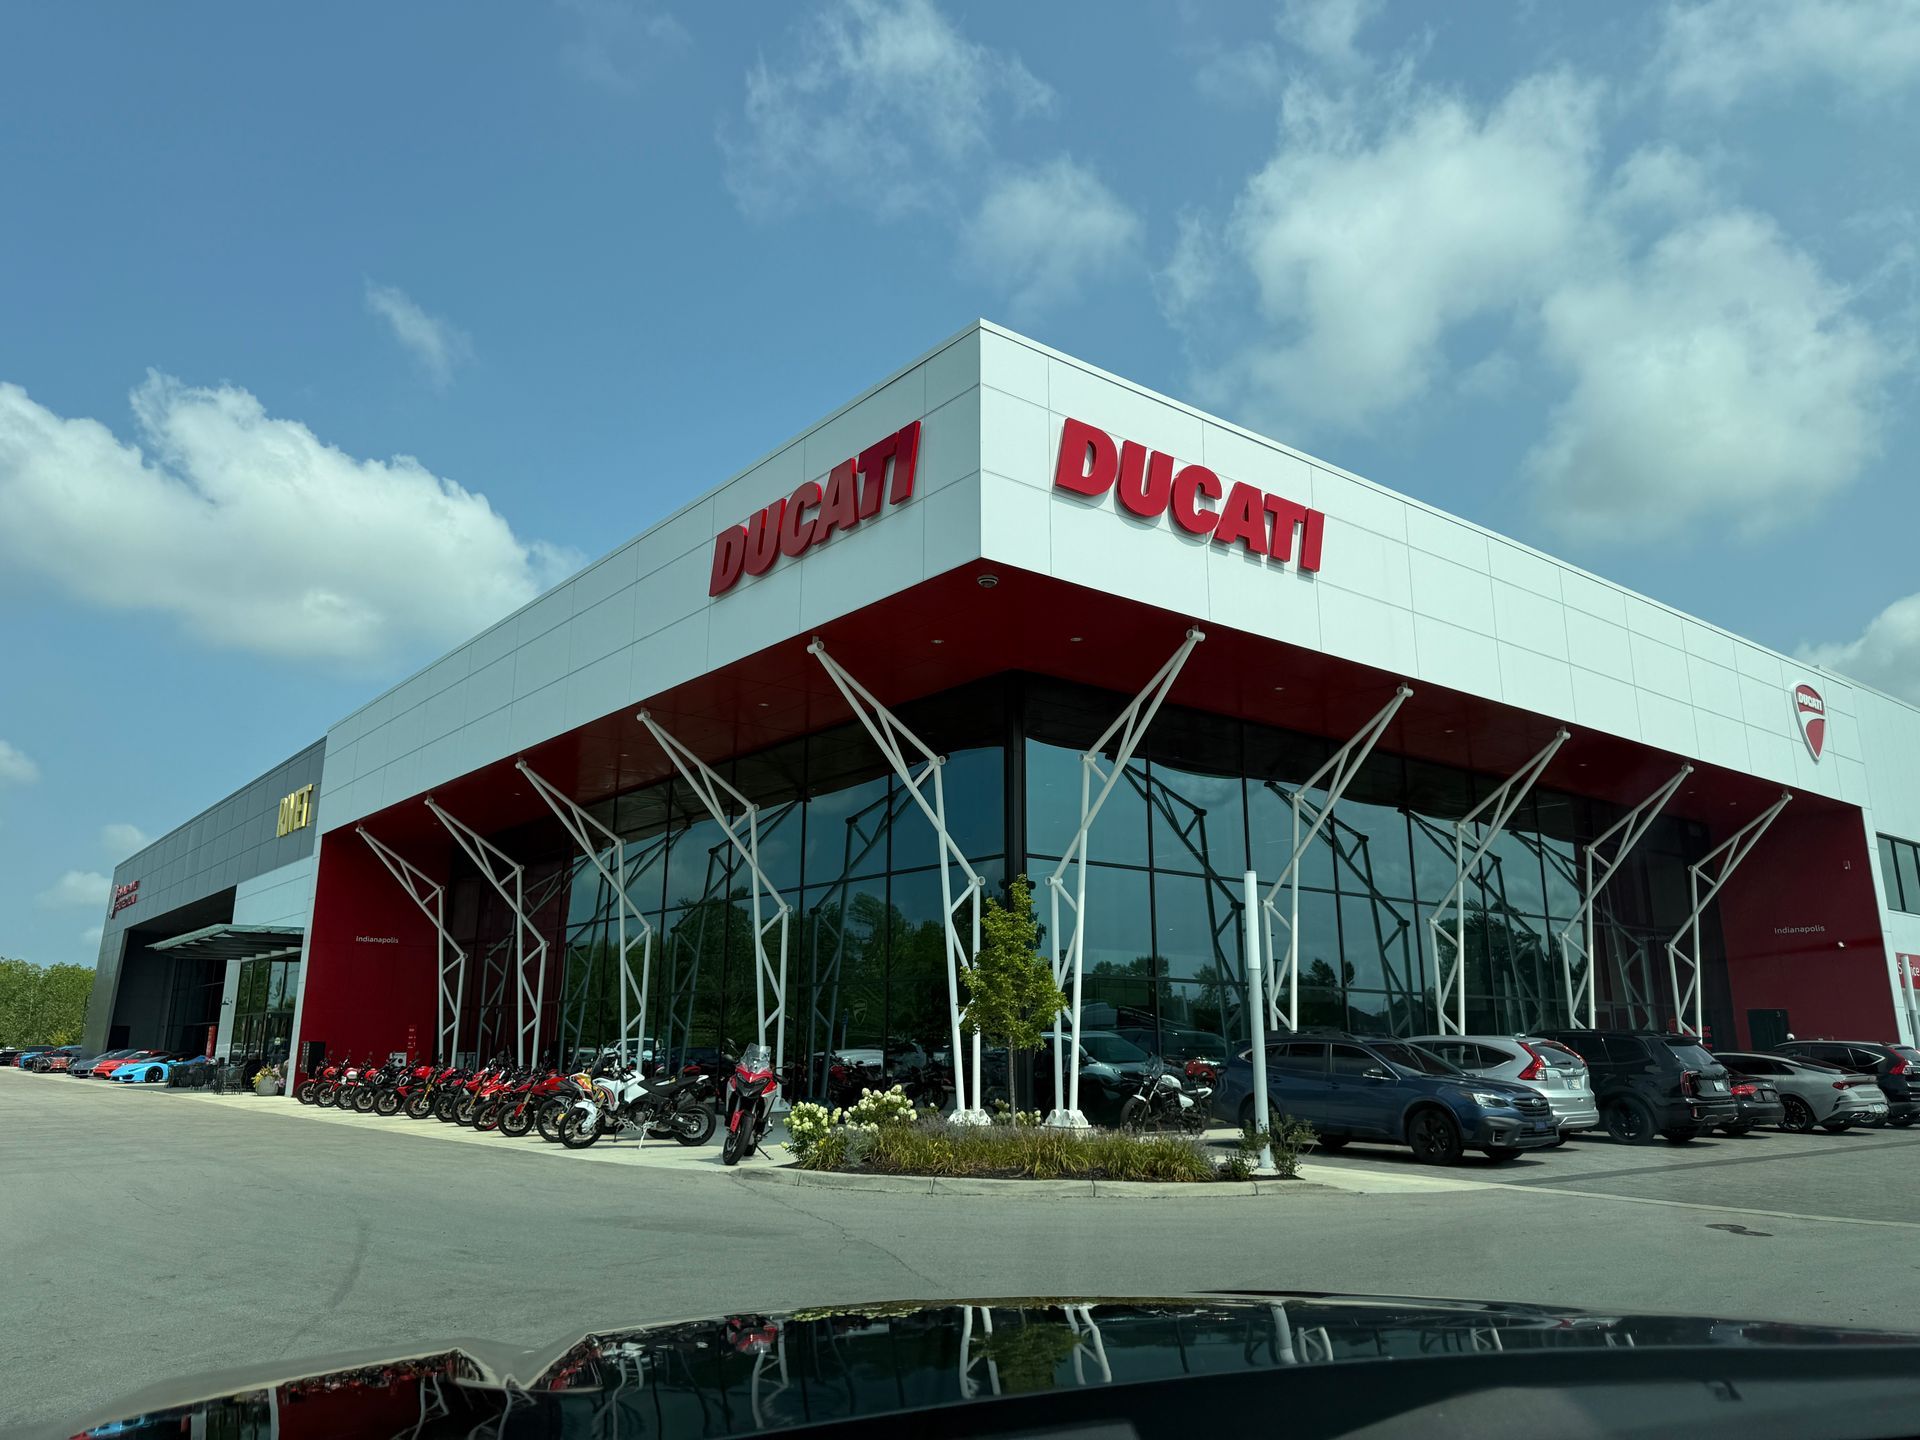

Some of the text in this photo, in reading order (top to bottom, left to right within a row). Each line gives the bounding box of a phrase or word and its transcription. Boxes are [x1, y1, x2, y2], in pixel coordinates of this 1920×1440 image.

[1055, 417, 1325, 573] DUCATI
[709, 420, 922, 597] DUCATI
[1798, 693, 1822, 711] DUCATI
[1774, 924, 1825, 934] Indianapolis
[355, 935, 399, 944] Indianapolis
[1897, 962, 1920, 977] Sice
